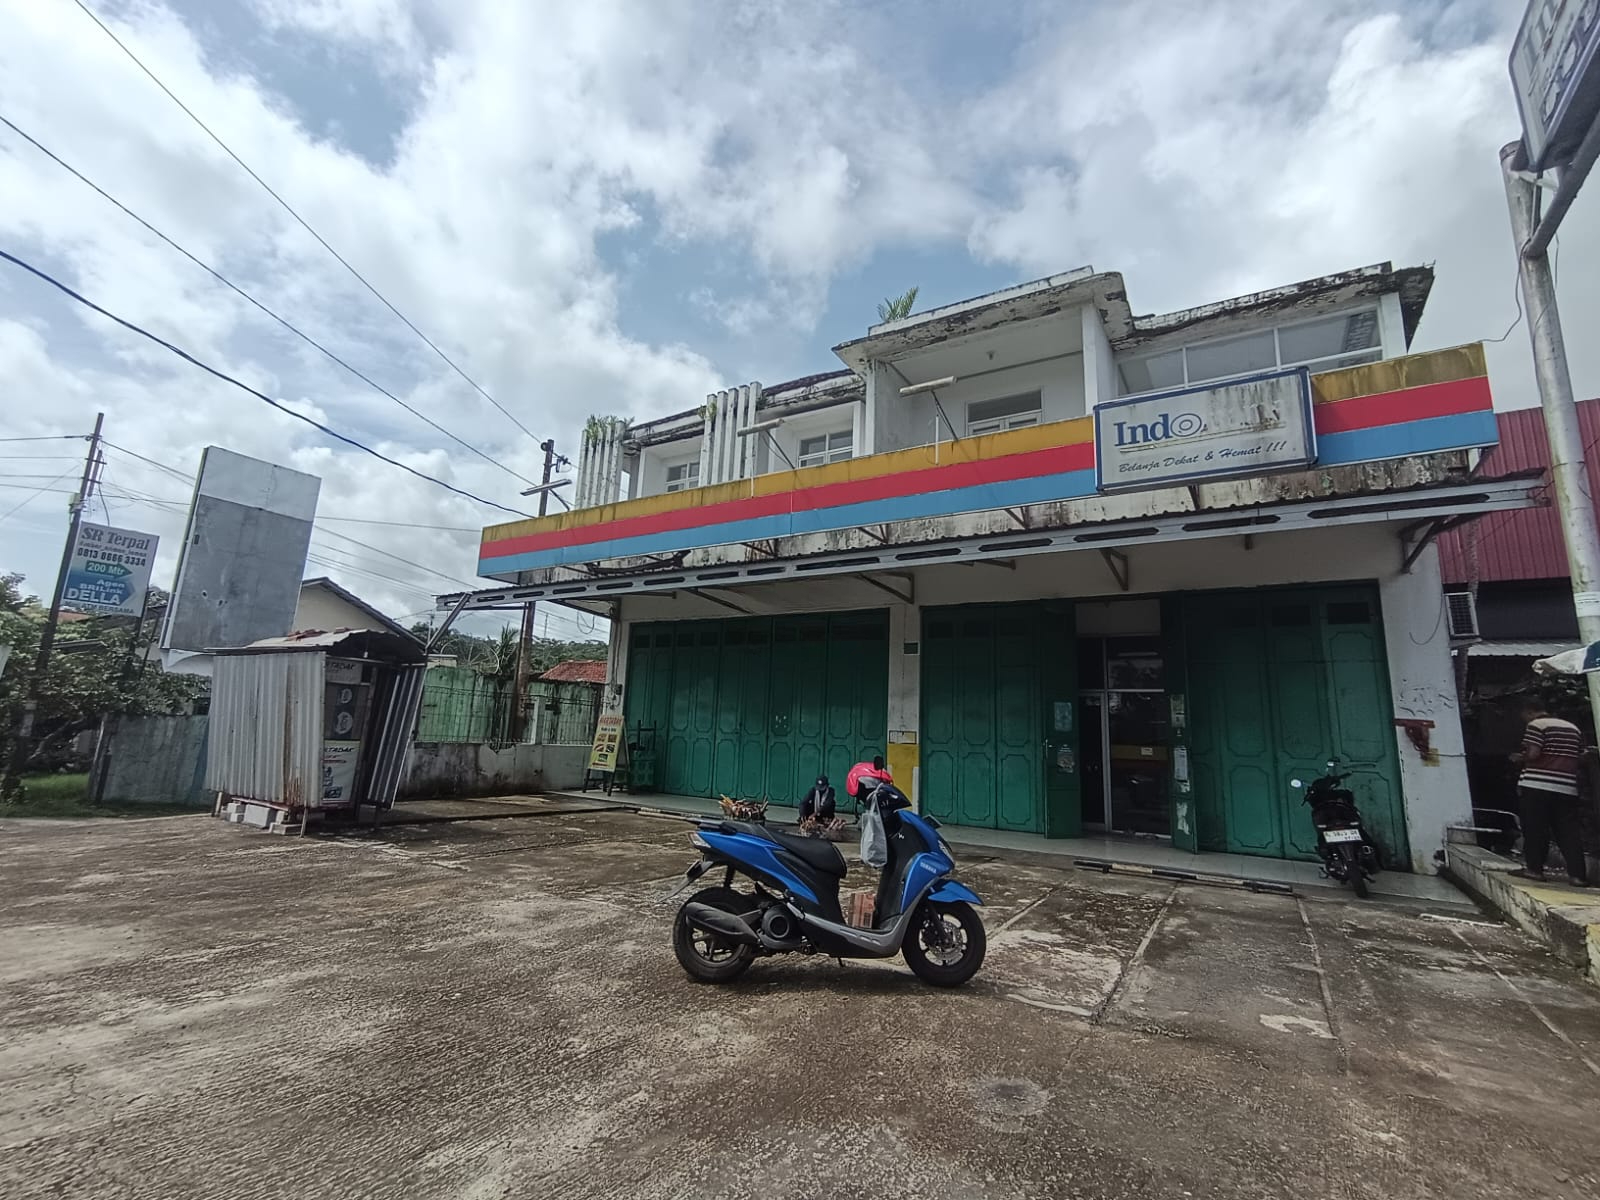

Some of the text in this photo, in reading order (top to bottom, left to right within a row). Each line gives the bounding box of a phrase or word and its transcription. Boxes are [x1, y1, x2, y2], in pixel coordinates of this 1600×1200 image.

[1119, 462, 1160, 473] Belanja
[1163, 455, 1199, 467] Dekat
[1204, 451, 1214, 461] &
[1219, 445, 1262, 458] Hemat
[81, 527, 104, 541] SR
[107, 532, 150, 550] Terpal
[88, 562, 126, 575] 200 Mtr
[79, 583, 122, 594] BRILink
[97, 579, 125, 588] Agen
[66, 588, 120, 605] DELLA
[99, 605, 135, 614] BERSAMA
